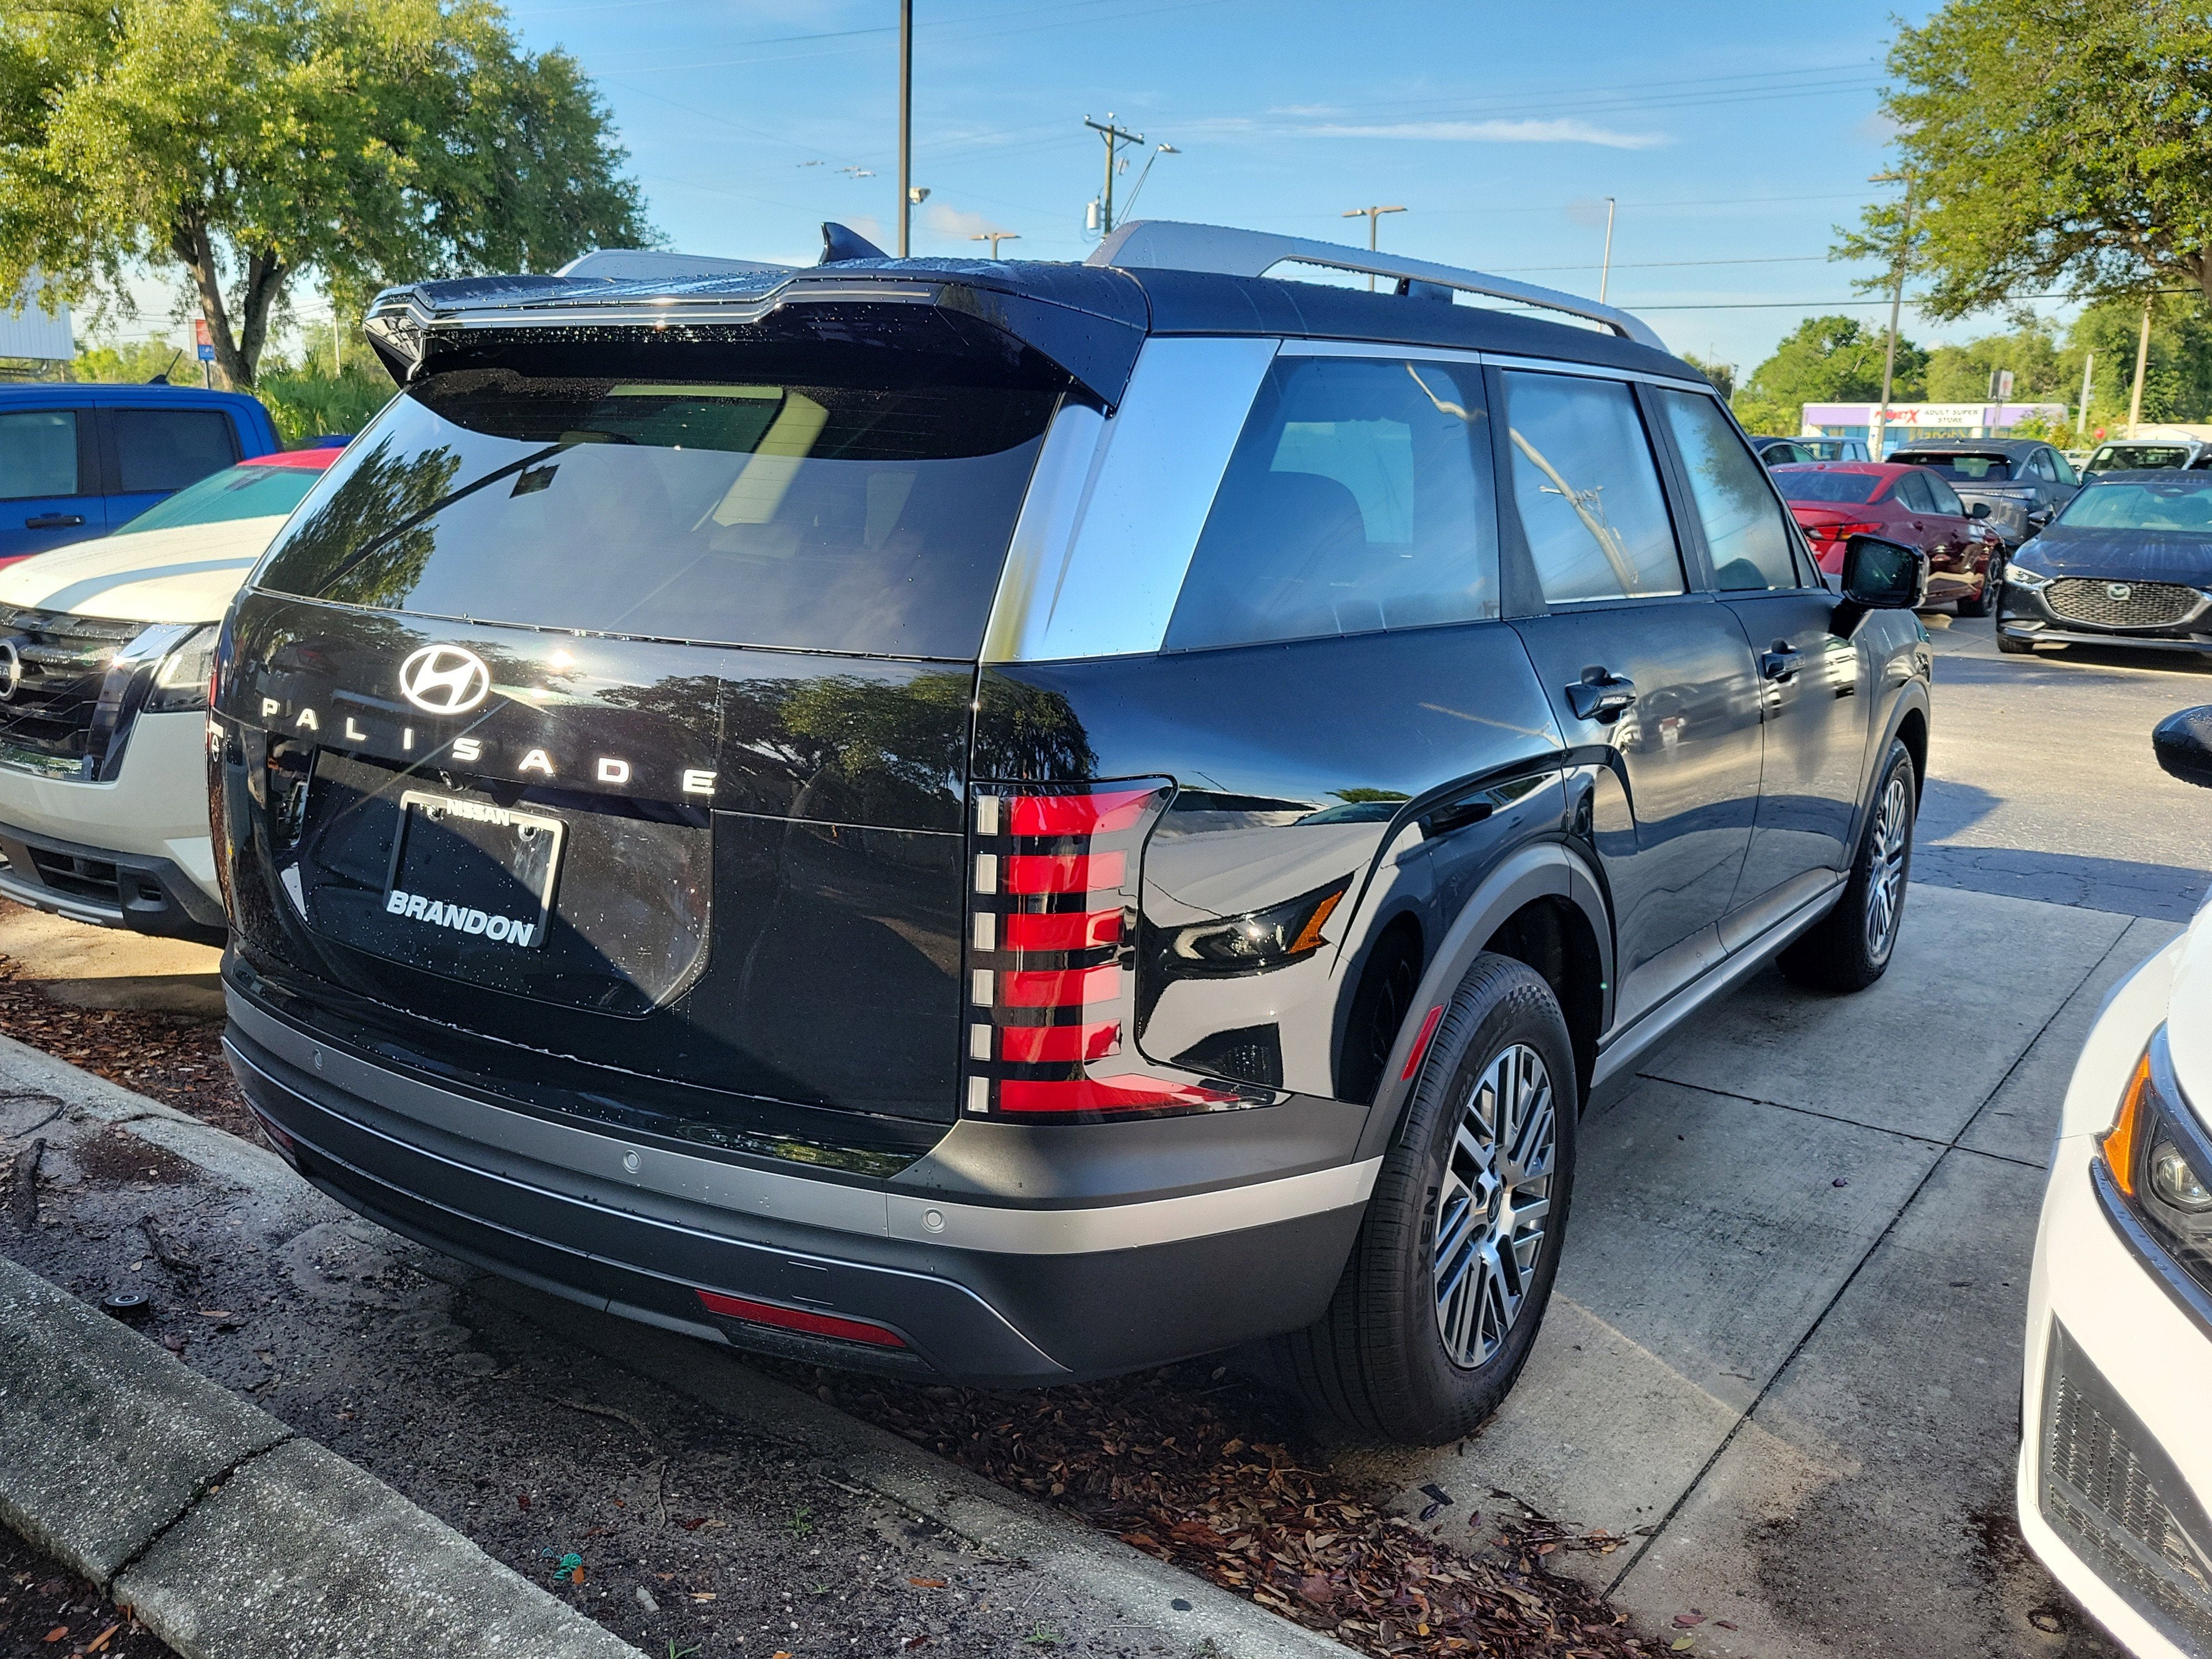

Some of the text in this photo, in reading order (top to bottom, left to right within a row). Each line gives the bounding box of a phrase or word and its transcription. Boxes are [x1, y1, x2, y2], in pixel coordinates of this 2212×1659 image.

[262, 699, 717, 795] PALISADE
[446, 798, 511, 827] NISSAN
[386, 890, 535, 947] BRANDON
